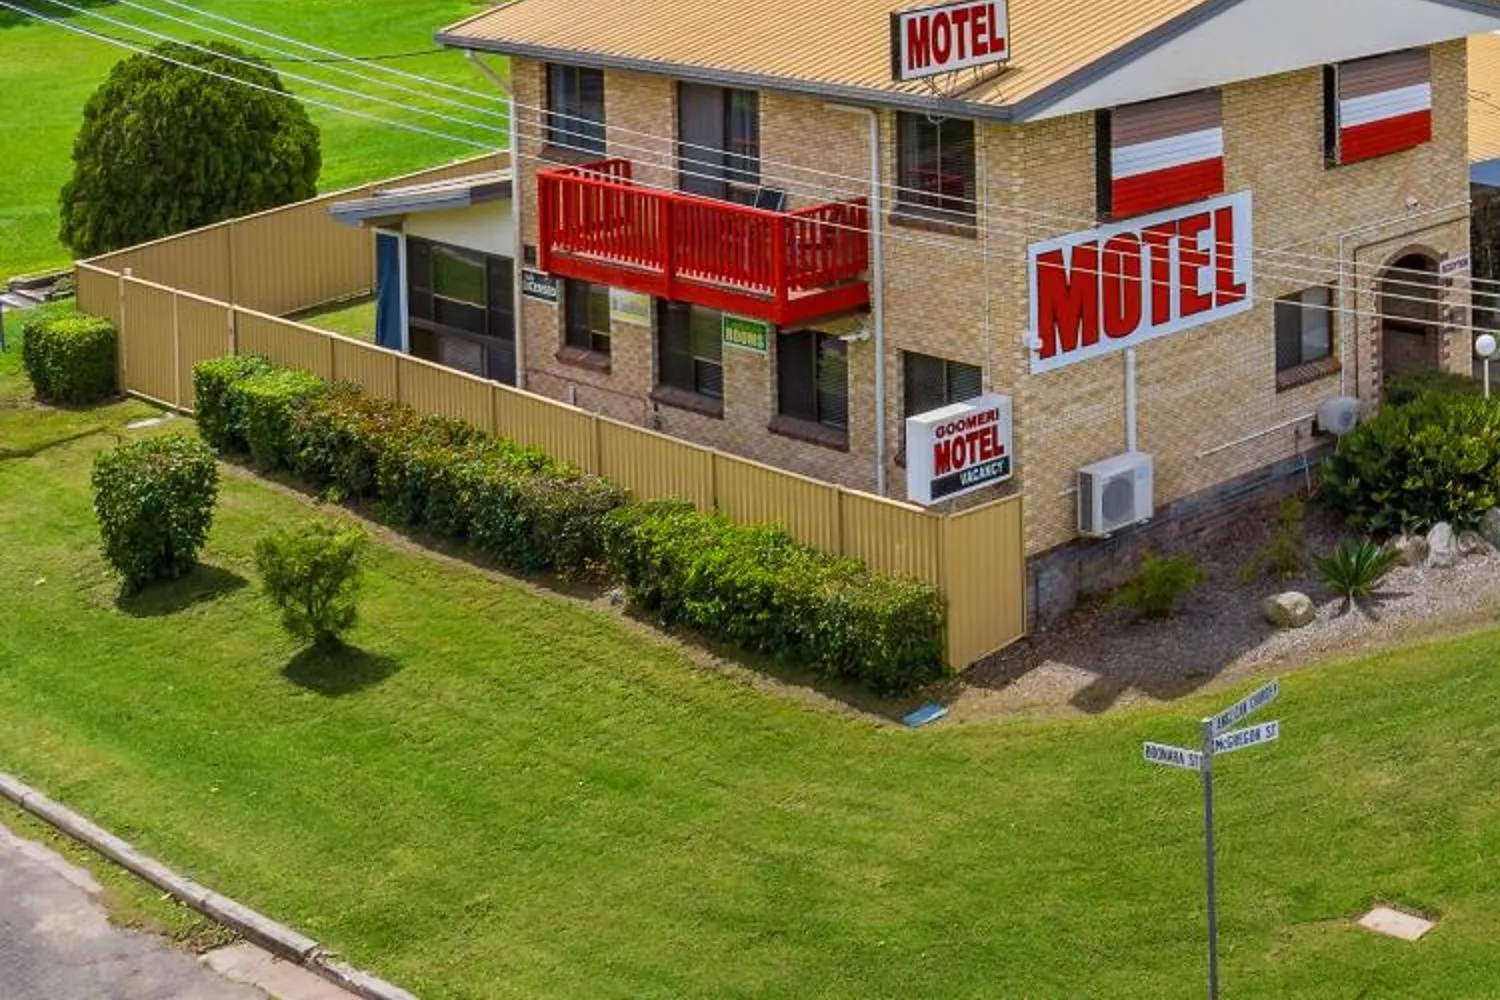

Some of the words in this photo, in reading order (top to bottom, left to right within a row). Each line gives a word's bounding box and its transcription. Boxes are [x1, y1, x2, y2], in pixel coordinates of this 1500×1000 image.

[907, 3, 1005, 71] MOTEL
[1036, 205, 1247, 360] MOTEL
[935, 407, 999, 439] GOOMERI
[934, 424, 1005, 477] MOTEL
[960, 459, 1005, 487] VACANCY
[1265, 722, 1277, 739] ST
